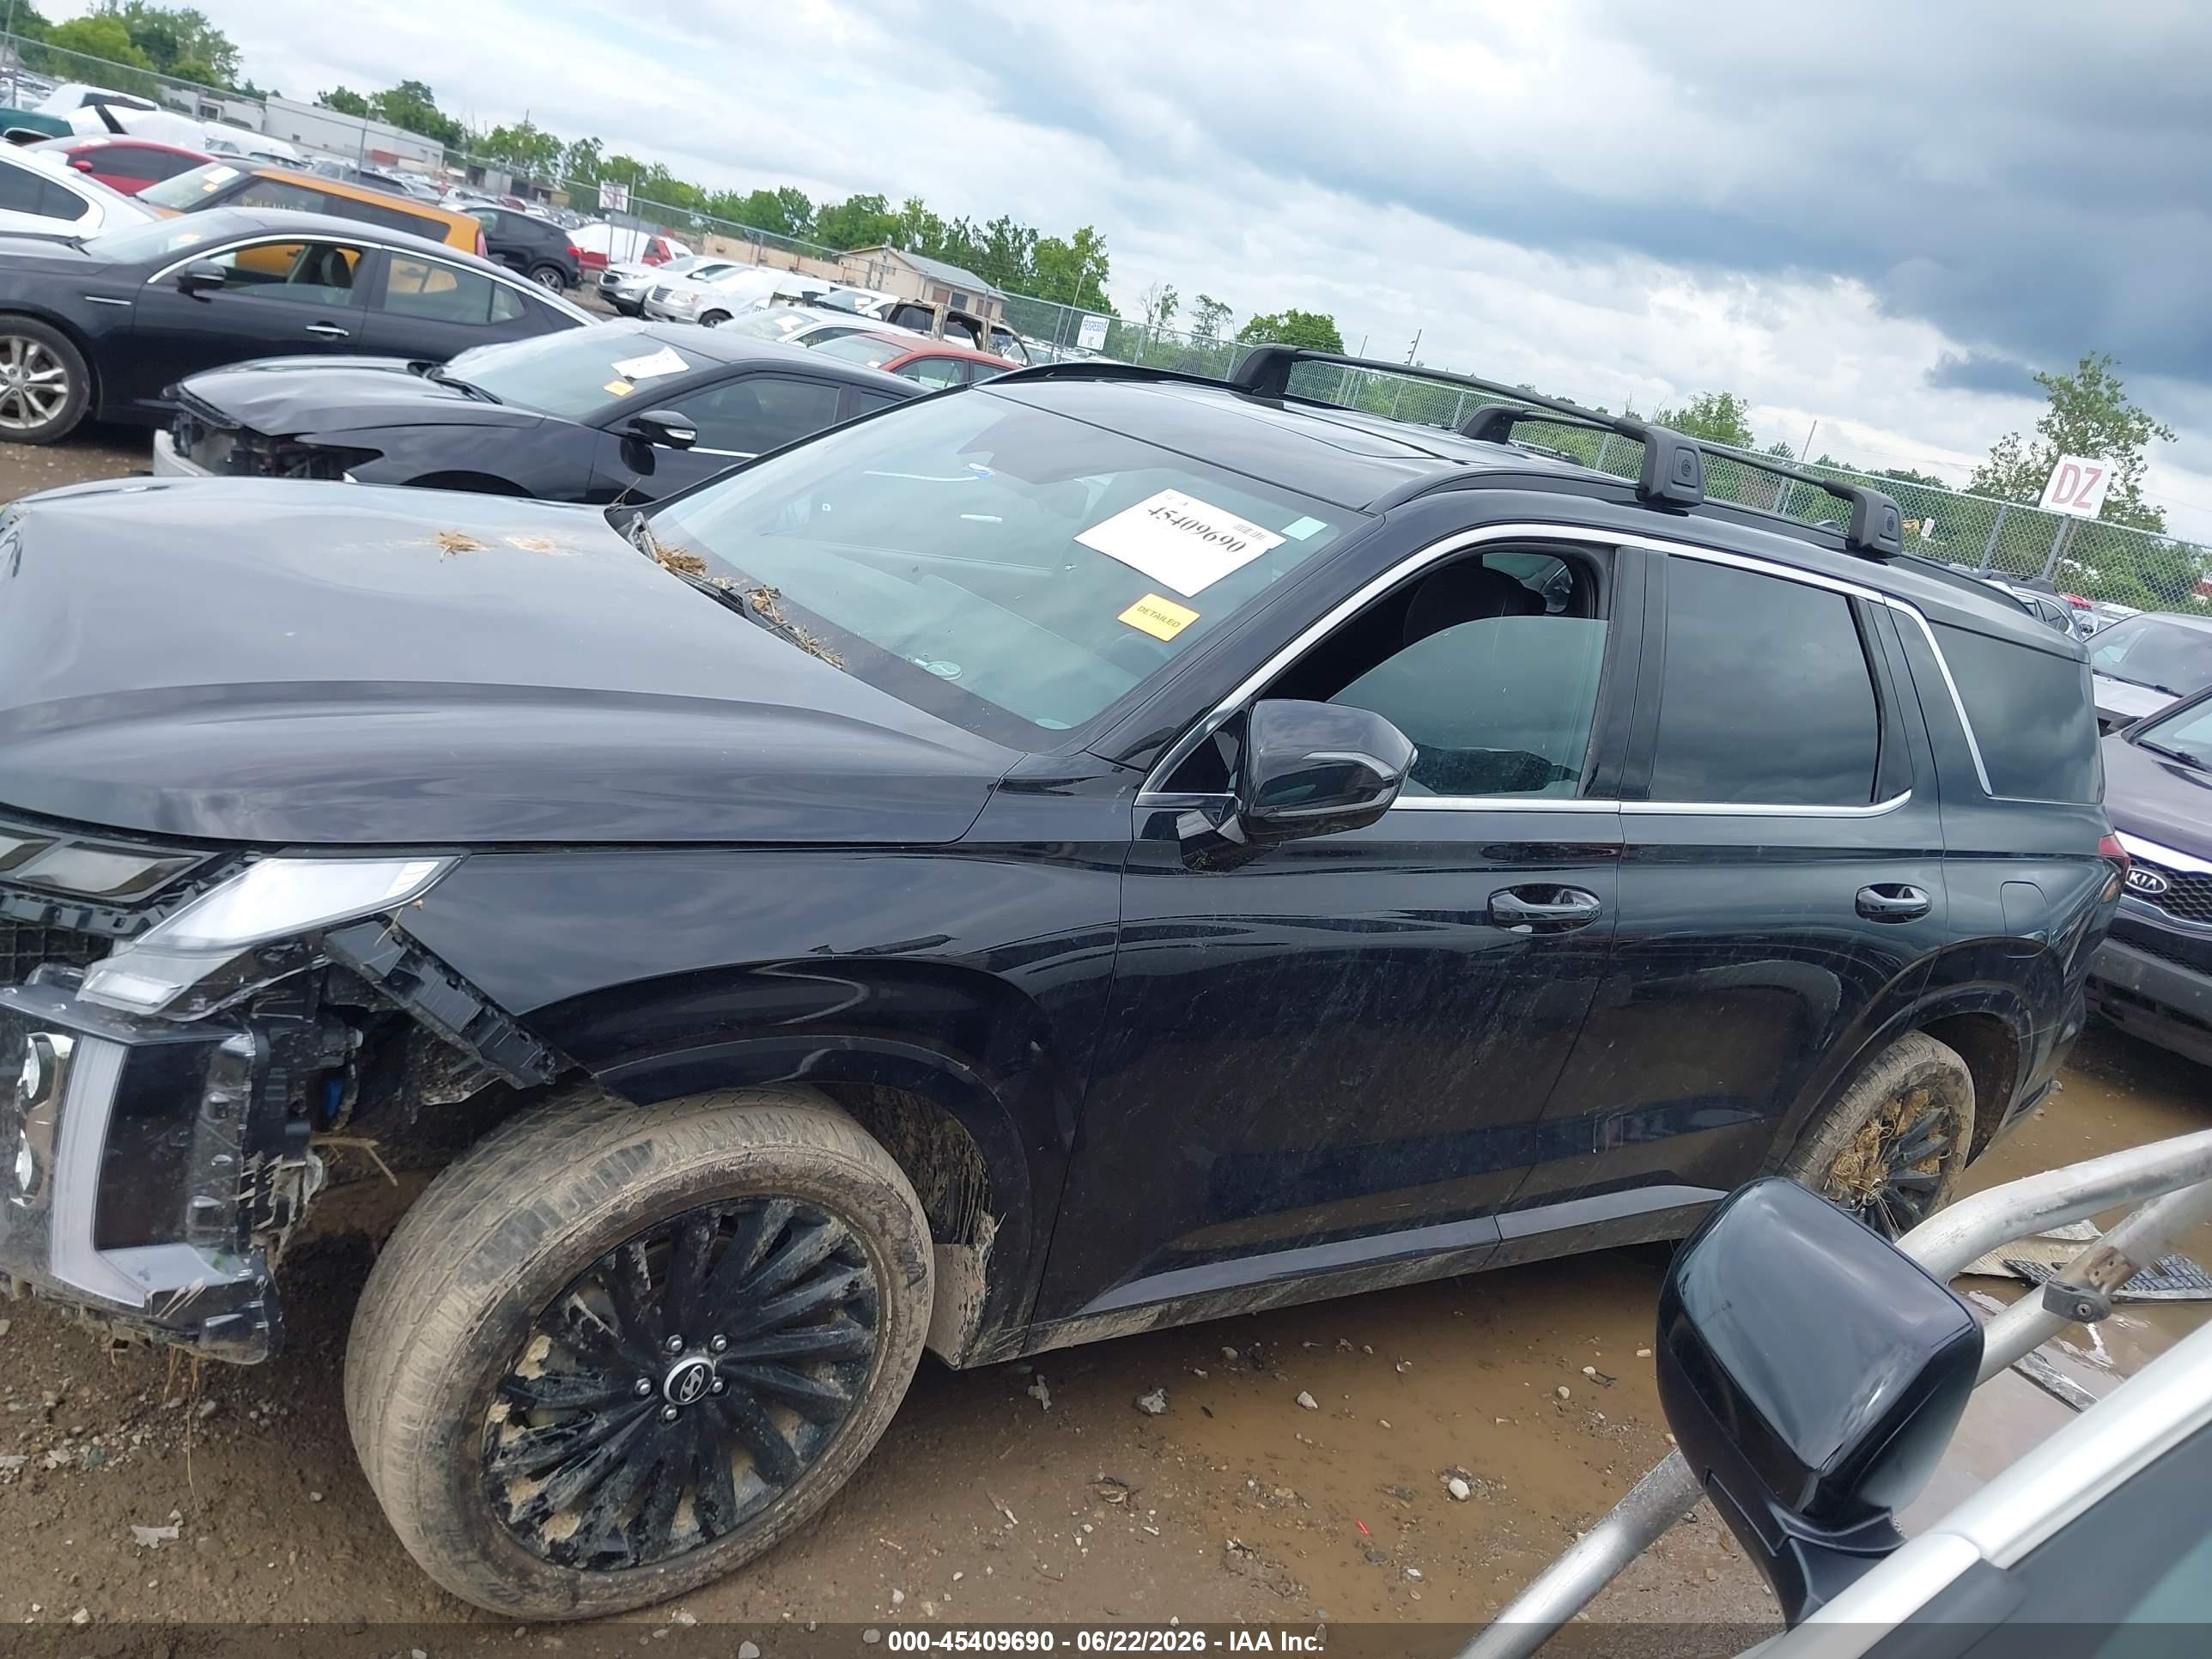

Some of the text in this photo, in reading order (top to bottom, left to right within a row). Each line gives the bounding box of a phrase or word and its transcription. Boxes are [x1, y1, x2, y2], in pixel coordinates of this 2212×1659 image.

[2051, 463, 2103, 509] DZ
[1147, 506, 1247, 553] 45409690
[1136, 605, 1182, 628] DETAILED
[2130, 871, 2158, 890] KIA
